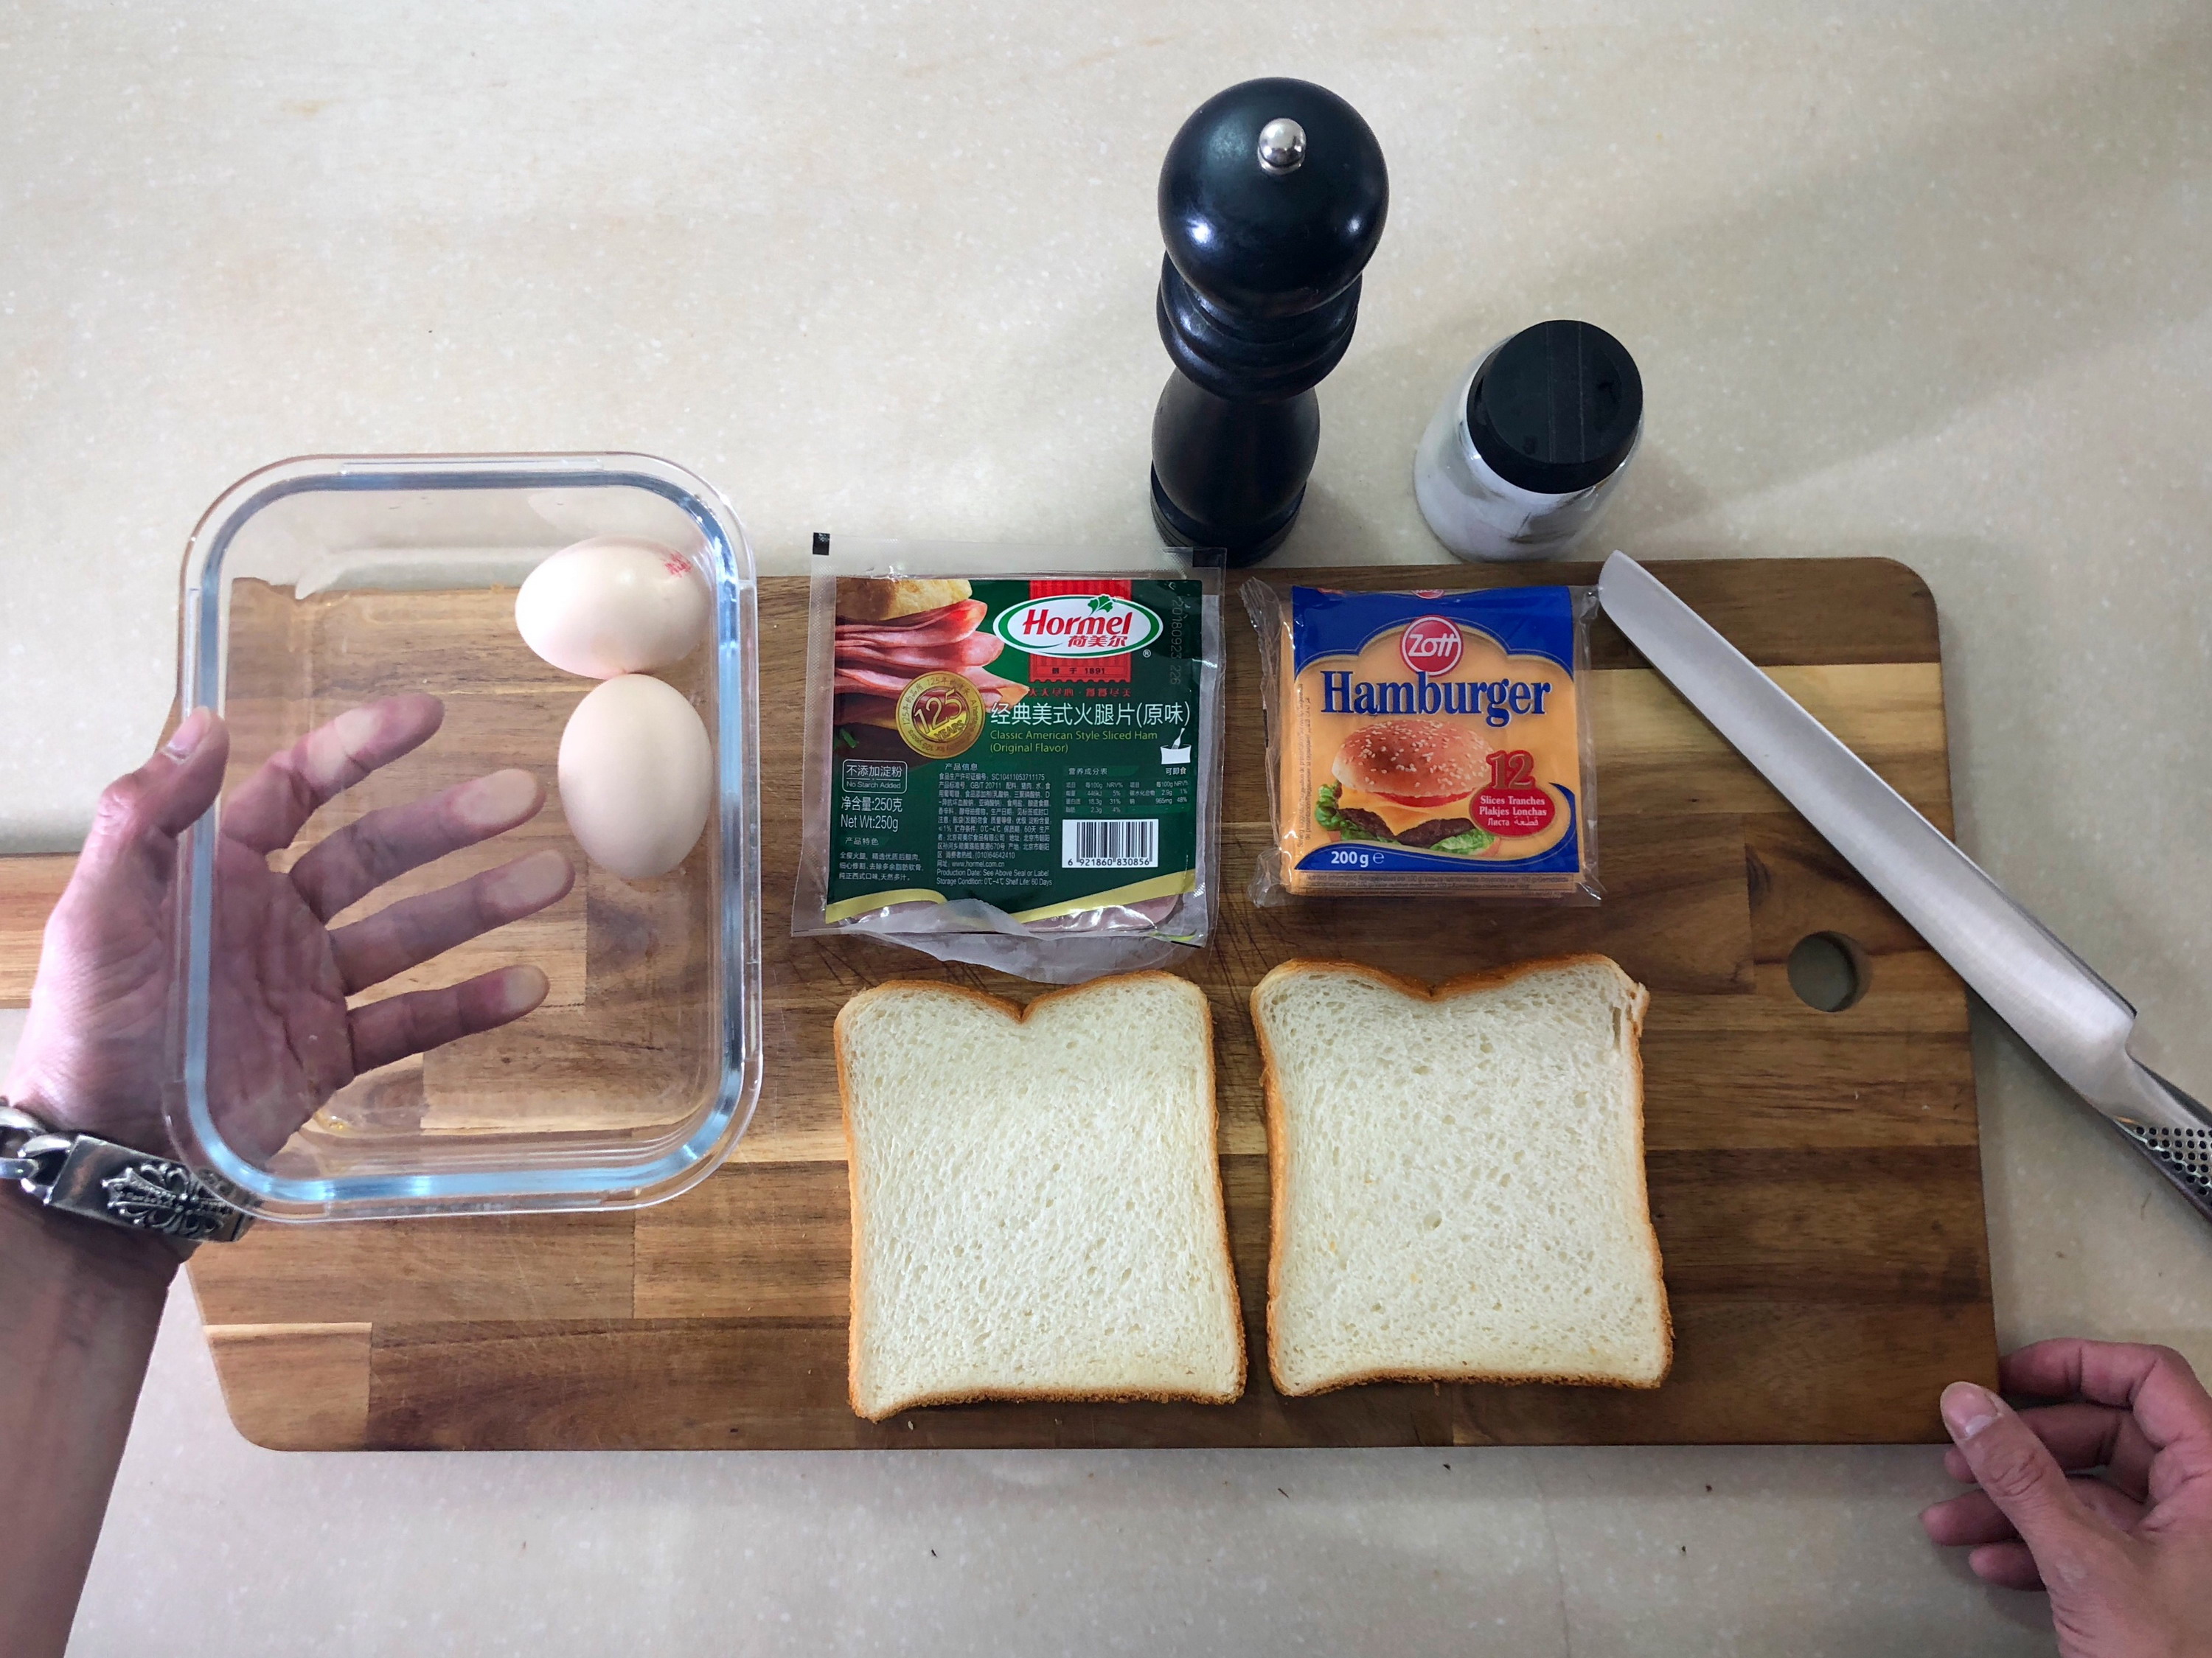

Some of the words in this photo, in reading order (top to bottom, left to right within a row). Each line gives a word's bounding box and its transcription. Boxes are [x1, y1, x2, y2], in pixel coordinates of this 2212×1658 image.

[1023, 609, 1133, 635] Hormel
[1068, 635, 1128, 648] 荷美尔
[1408, 633, 1459, 657] Zott
[1320, 670, 1552, 728] Hamburger
[914, 688, 962, 734] 125
[990, 700, 1192, 728] 经典美式火腿片(原味)
[933, 720, 967, 741] YEARS
[990, 730, 1022, 740] Classic
[1025, 730, 1073, 740] American
[1076, 730, 1100, 742] Style
[1102, 730, 1132, 740] Sliced
[1134, 730, 1158, 740] Ham
[990, 742, 1033, 754] (Original
[1035, 742, 1068, 753] Flavor)
[846, 764, 903, 778] 不添加淀粉
[945, 762, 978, 771] 产品信息
[1165, 766, 1187, 775] 可即食
[1489, 753, 1533, 790] 12
[1161, 789, 1173, 797] 2.9g
[841, 795, 903, 812] 净含量:250克
[1480, 795, 1506, 805] Slices
[1508, 795, 1545, 806] Tranches
[1479, 806, 1509, 817] Plakjes
[1512, 807, 1548, 816] Lonchas
[841, 814, 858, 829] Net
[859, 815, 899, 832] Wt:250g
[1487, 818, 1510, 826] Листа
[845, 837, 880, 846] 产品特色
[1067, 858, 1074, 866] 6
[1079, 858, 1113, 866] 921860
[1116, 858, 1150, 866] 830856
[1330, 851, 1358, 864] 200
[1359, 854, 1369, 868] g
[936, 868, 966, 877] Production
[967, 868, 981, 877] Date:
[983, 868, 994, 877] See
[995, 868, 1012, 877] Above
[1014, 868, 1026, 877] Seal
[936, 877, 957, 886] Storage
[1039, 878, 1053, 887] Days
